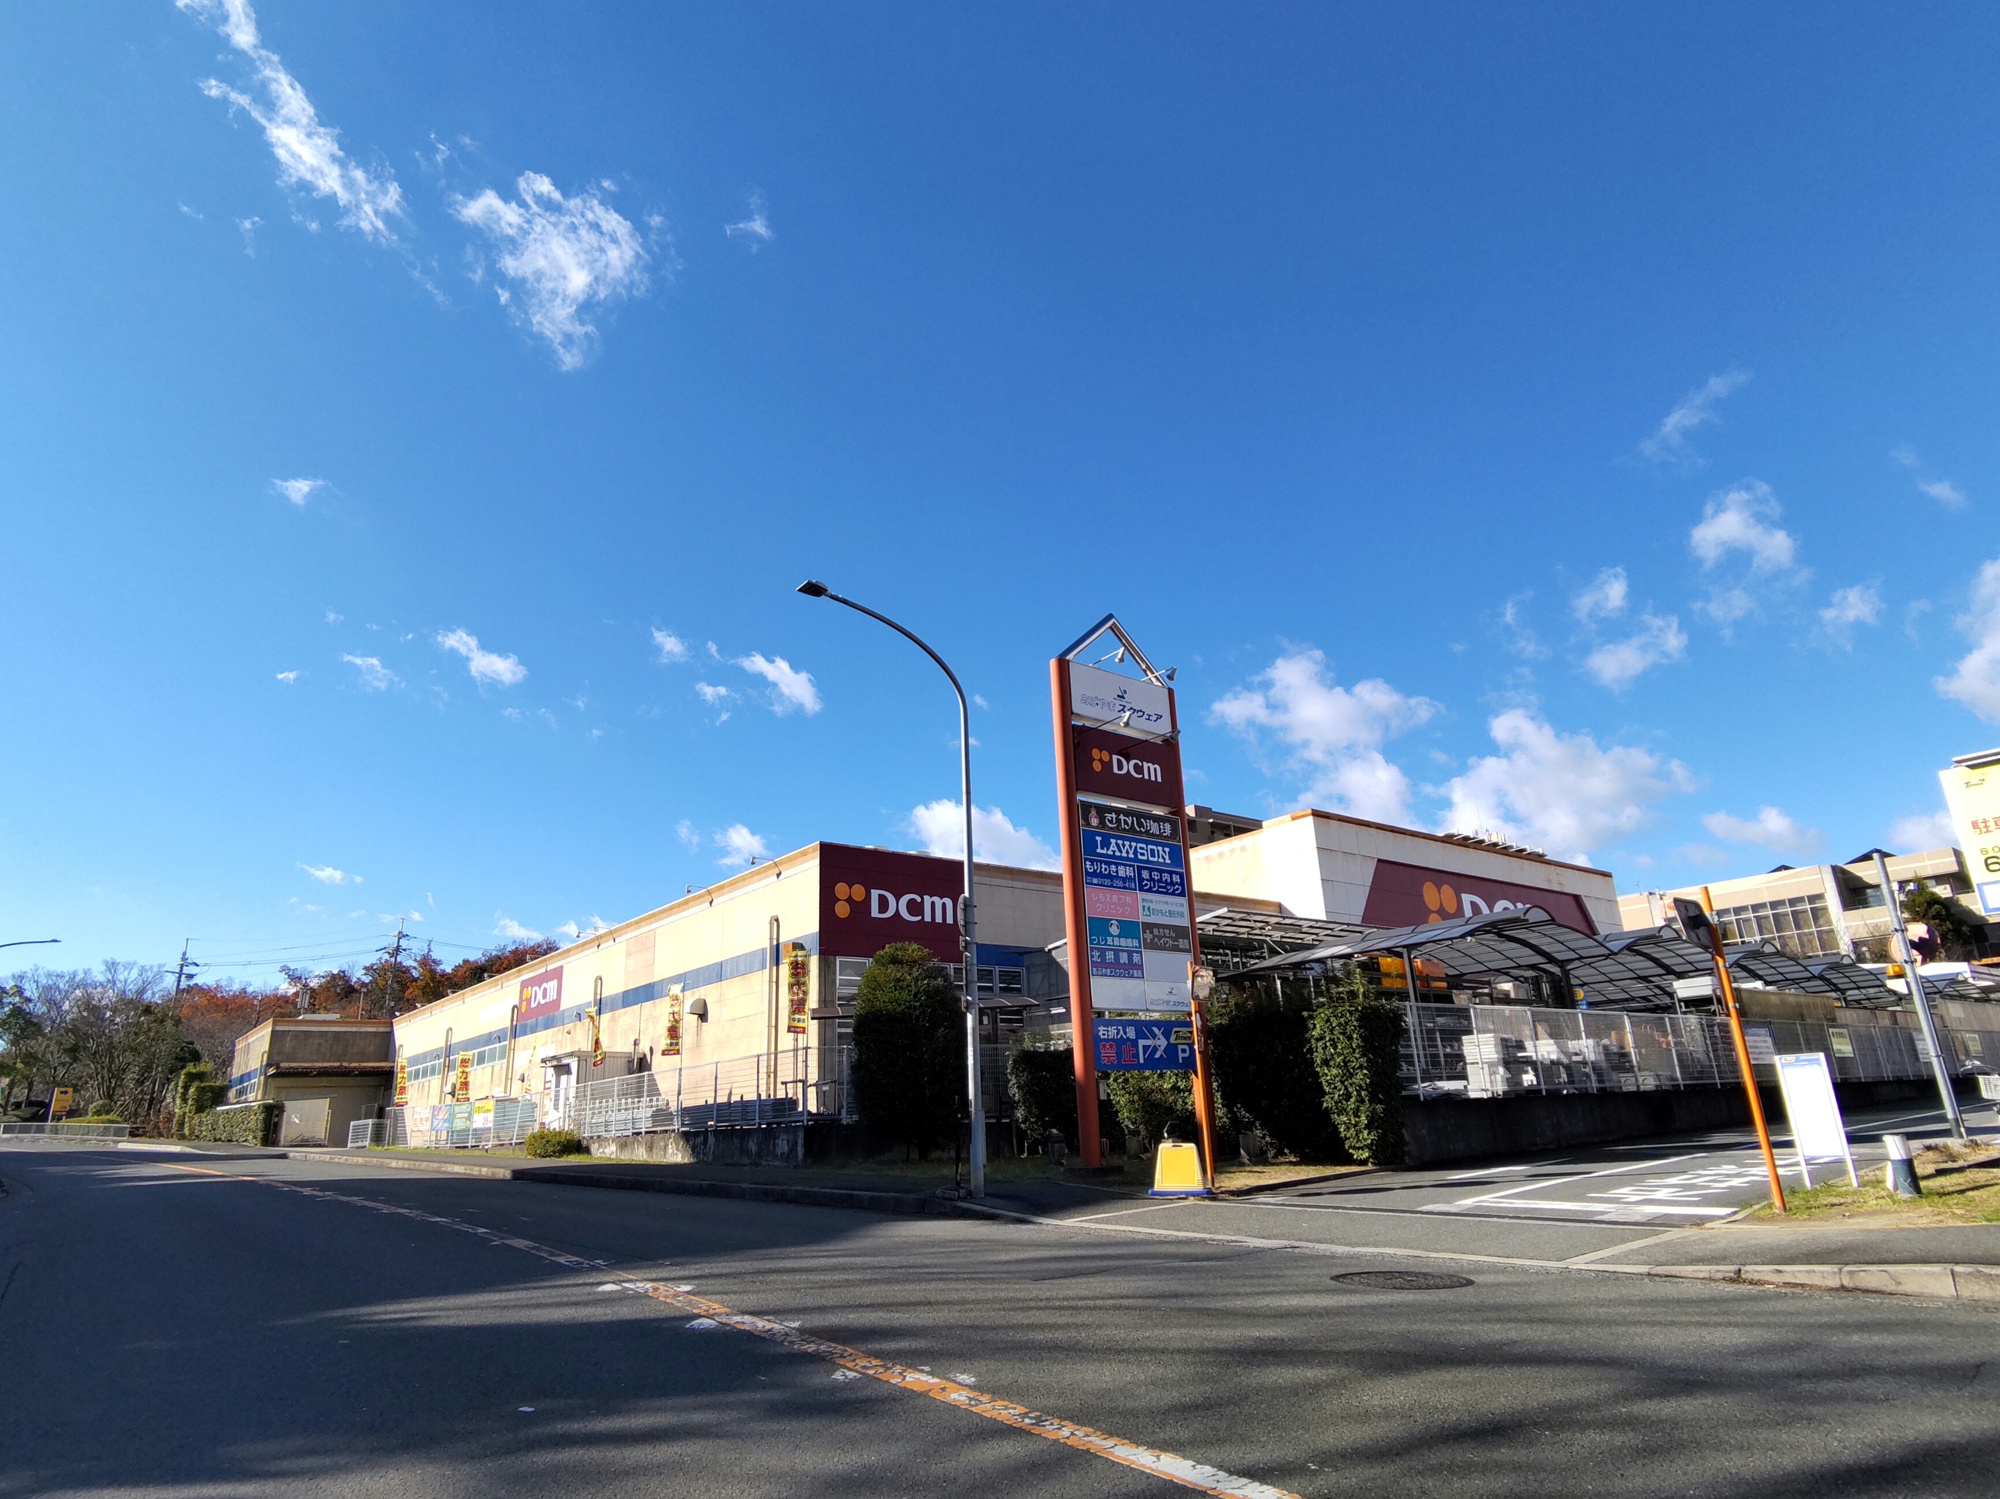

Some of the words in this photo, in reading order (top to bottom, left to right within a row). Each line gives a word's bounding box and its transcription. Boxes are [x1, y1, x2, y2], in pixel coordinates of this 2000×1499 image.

[1104, 812, 1172, 836] さかい珈琲
[1095, 836, 1171, 863] LAWSON
[1085, 860, 1135, 878] もりわき歯科
[1142, 880, 1182, 894] クリニック
[1096, 903, 1131, 915] クリニック
[1091, 949, 1142, 966] 北摂調剤
[1098, 1025, 1136, 1040] 右折入場
[1101, 1041, 1138, 1065] 禁止
[1178, 1044, 1190, 1063] P
